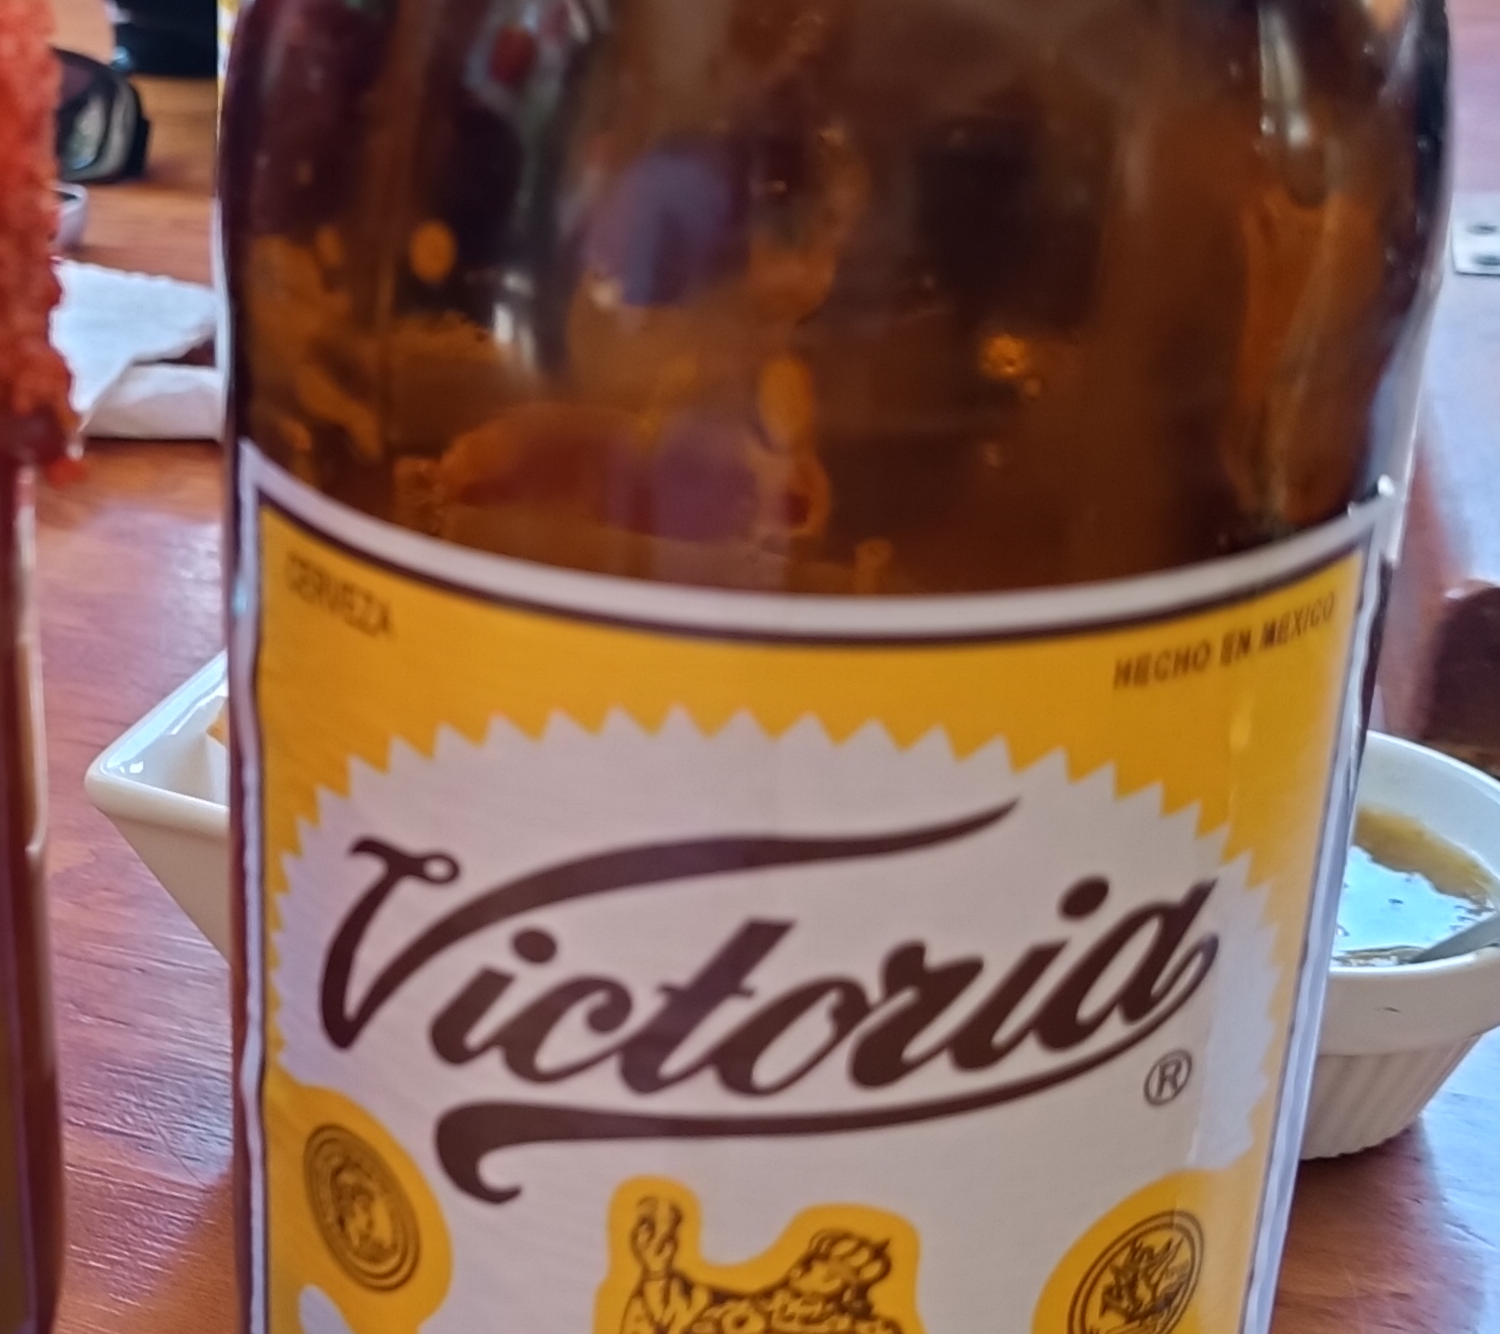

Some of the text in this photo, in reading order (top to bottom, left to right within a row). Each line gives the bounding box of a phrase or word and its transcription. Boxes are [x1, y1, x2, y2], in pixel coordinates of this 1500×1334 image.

[1113, 639, 1212, 691] HECHO
[1218, 626, 1252, 668] EN
[320, 797, 1220, 1202] Victoria
